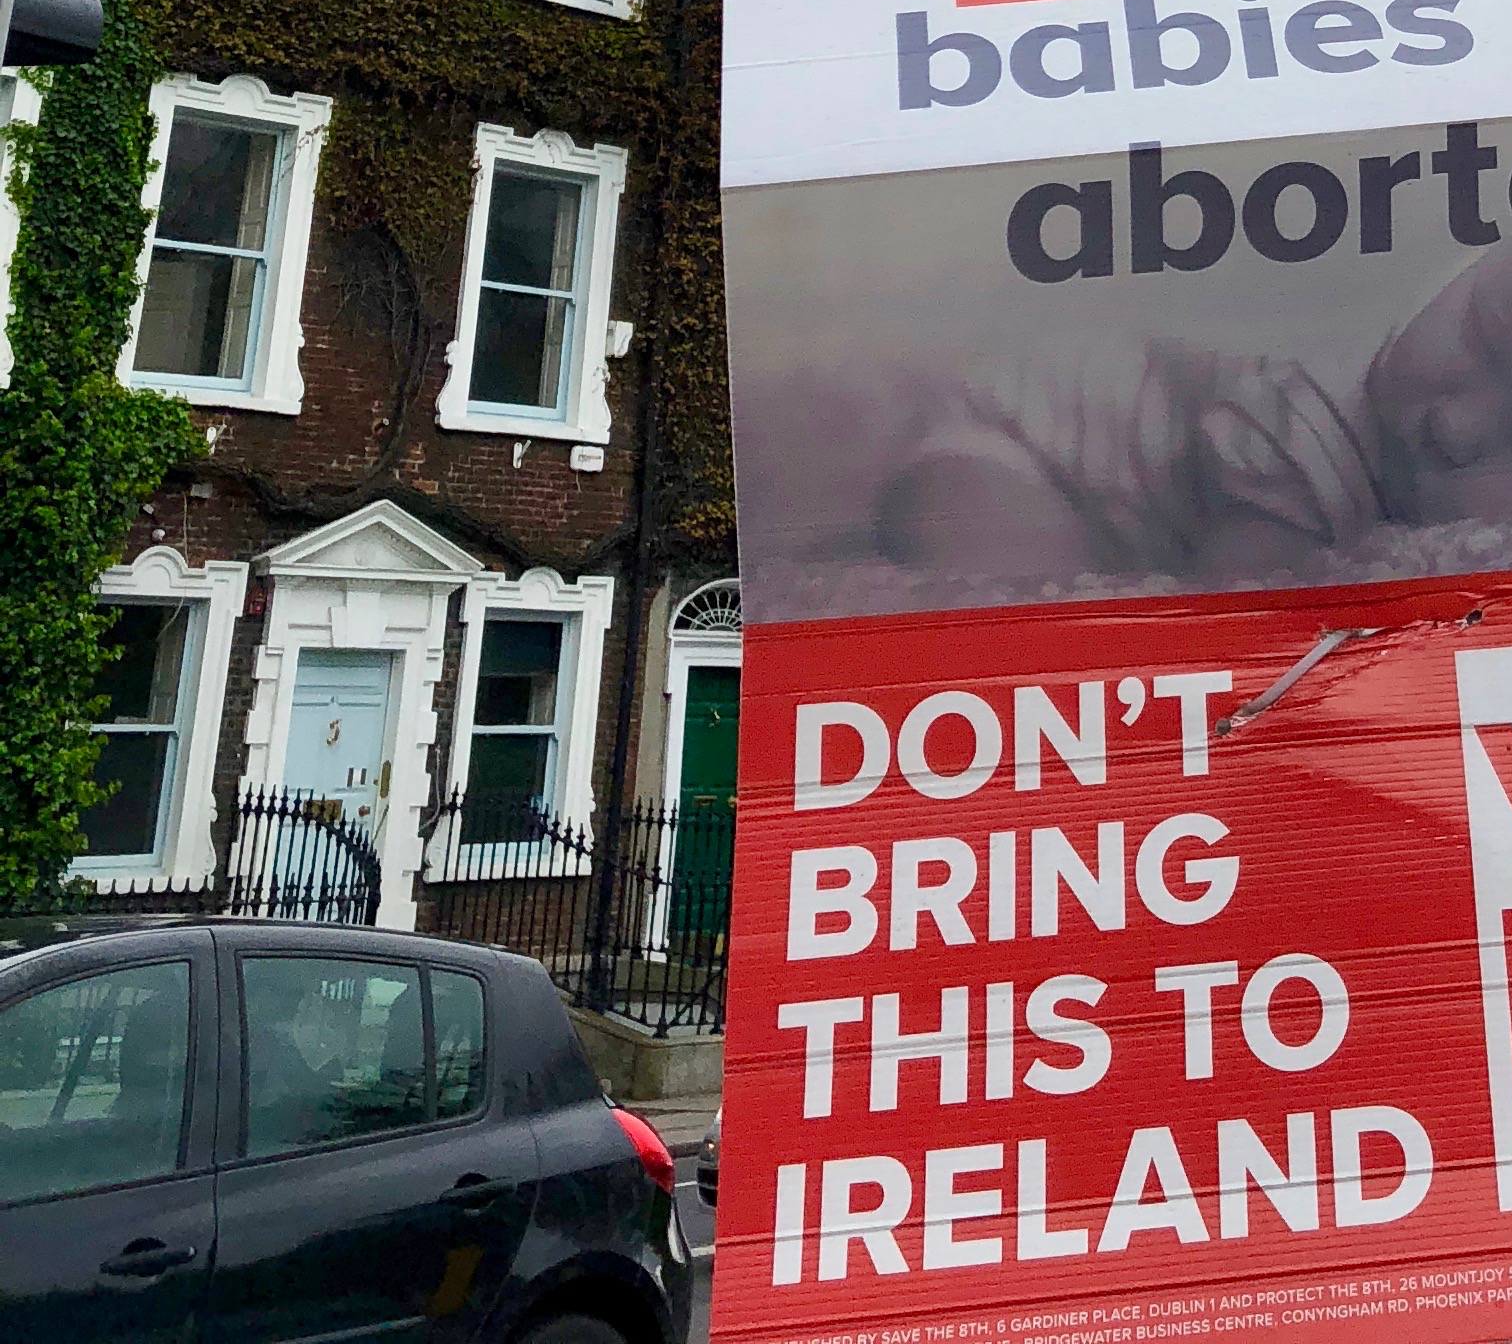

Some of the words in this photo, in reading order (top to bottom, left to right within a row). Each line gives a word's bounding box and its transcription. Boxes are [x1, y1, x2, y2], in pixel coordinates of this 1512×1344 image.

[793, 670, 1233, 812] DON'T
[786, 812, 1241, 962] BRING
[777, 974, 1113, 1120] THIS
[1154, 953, 1350, 1081] TO
[770, 1104, 1434, 1287] IRELAND
[881, 1328, 921, 1344] SAVE
[925, 1324, 955, 1341] THE
[996, 1320, 1006, 1334] 6
[1010, 1311, 1089, 1332] GARDINER
[1149, 1299, 1205, 1318] DUBLIN
[1209, 1298, 1216, 1311] 1
[1219, 1294, 1252, 1311] AND
[1256, 1286, 1325, 1306] PROTECT
[1329, 1282, 1358, 1299] THE
[1399, 1276, 1418, 1291] 26
[1421, 1267, 1505, 1289] MOUNTJOY
[1135, 1319, 1211, 1340] BUSINESS
[1281, 1300, 1383, 1324] CONYNGHAM
[1415, 1290, 1483, 1310] PHOENIX
